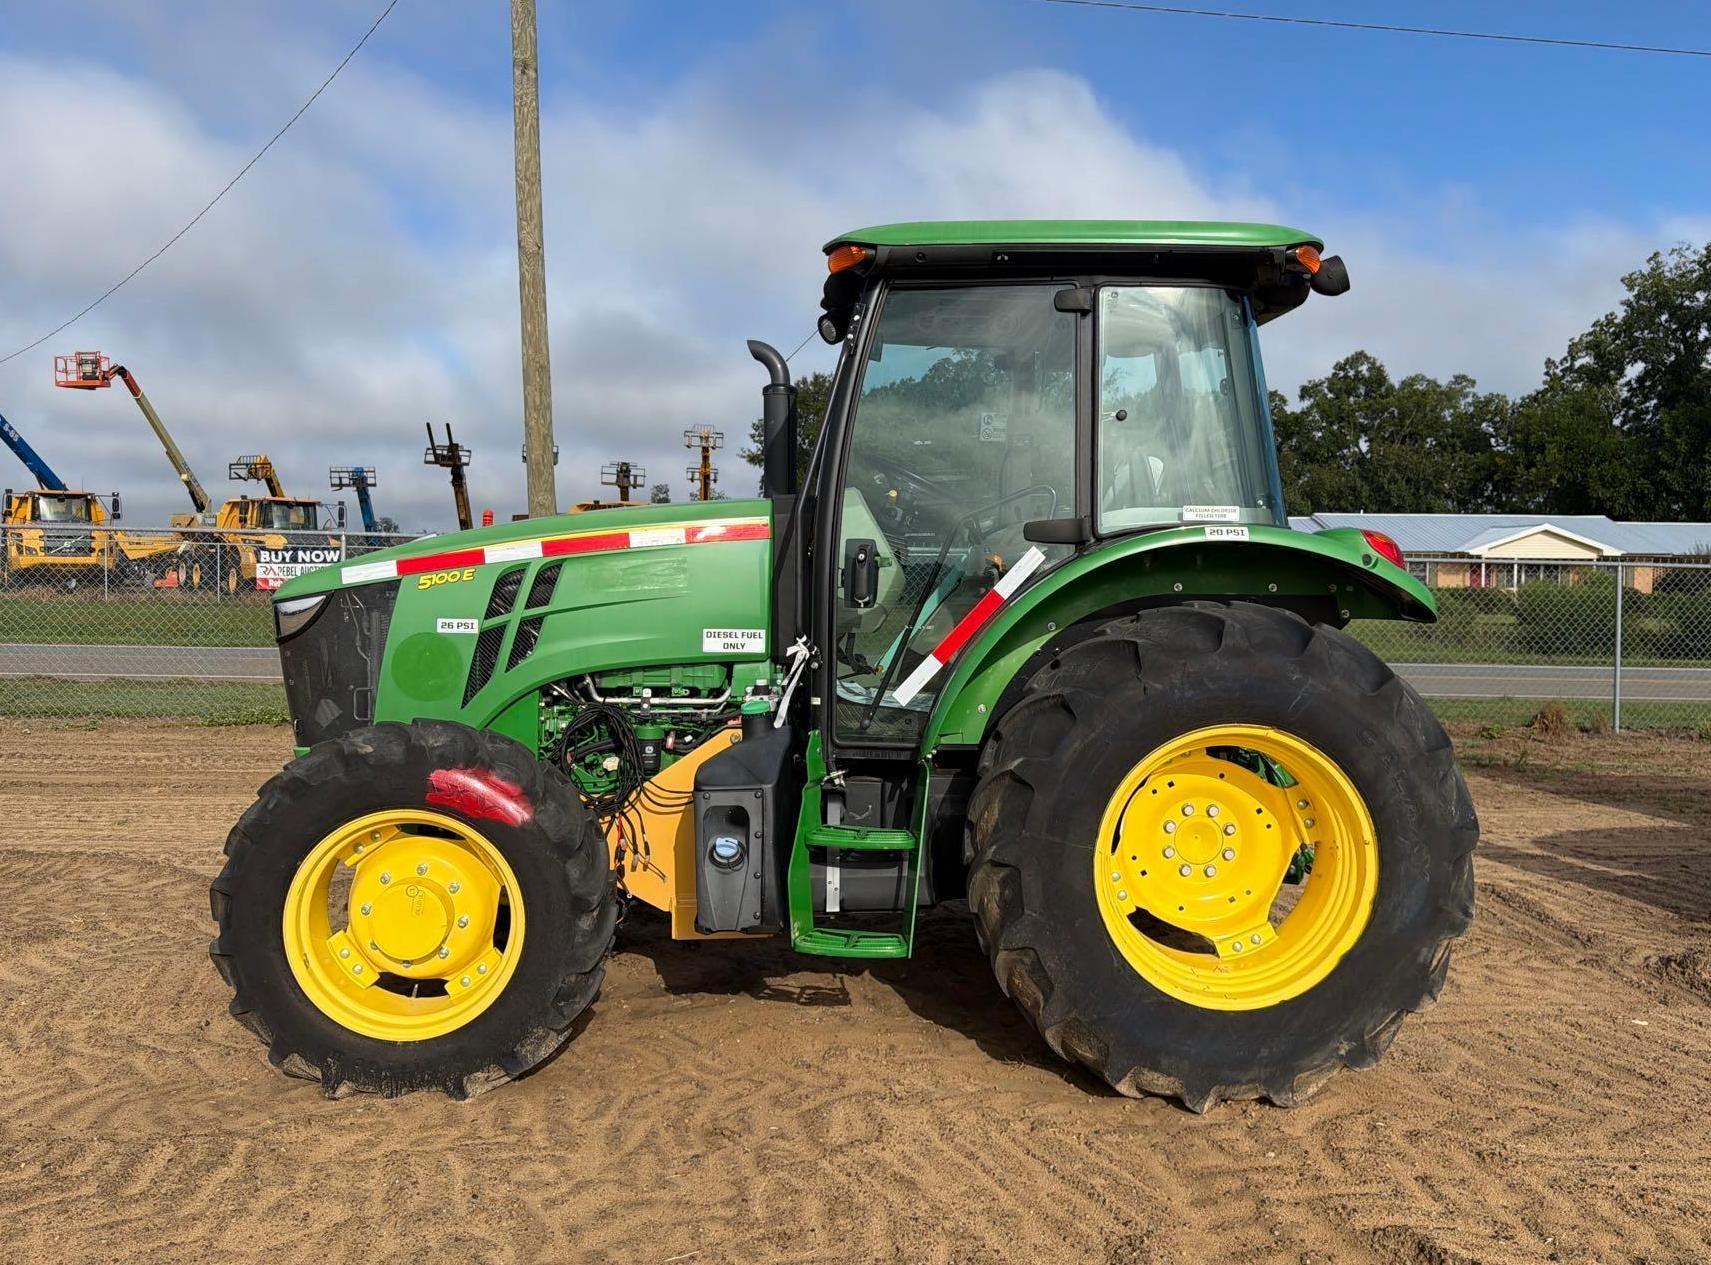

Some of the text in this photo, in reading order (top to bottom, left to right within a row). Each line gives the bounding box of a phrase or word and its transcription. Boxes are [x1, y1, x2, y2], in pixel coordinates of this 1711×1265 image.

[1209, 528, 1245, 537] 20 PSI
[260, 550, 340, 563] BUY NOW
[277, 566, 298, 577] REBEL
[440, 621, 475, 630] 26 PSI
[705, 631, 764, 639] DIESEL FUEL
[723, 642, 746, 650] ONLY
